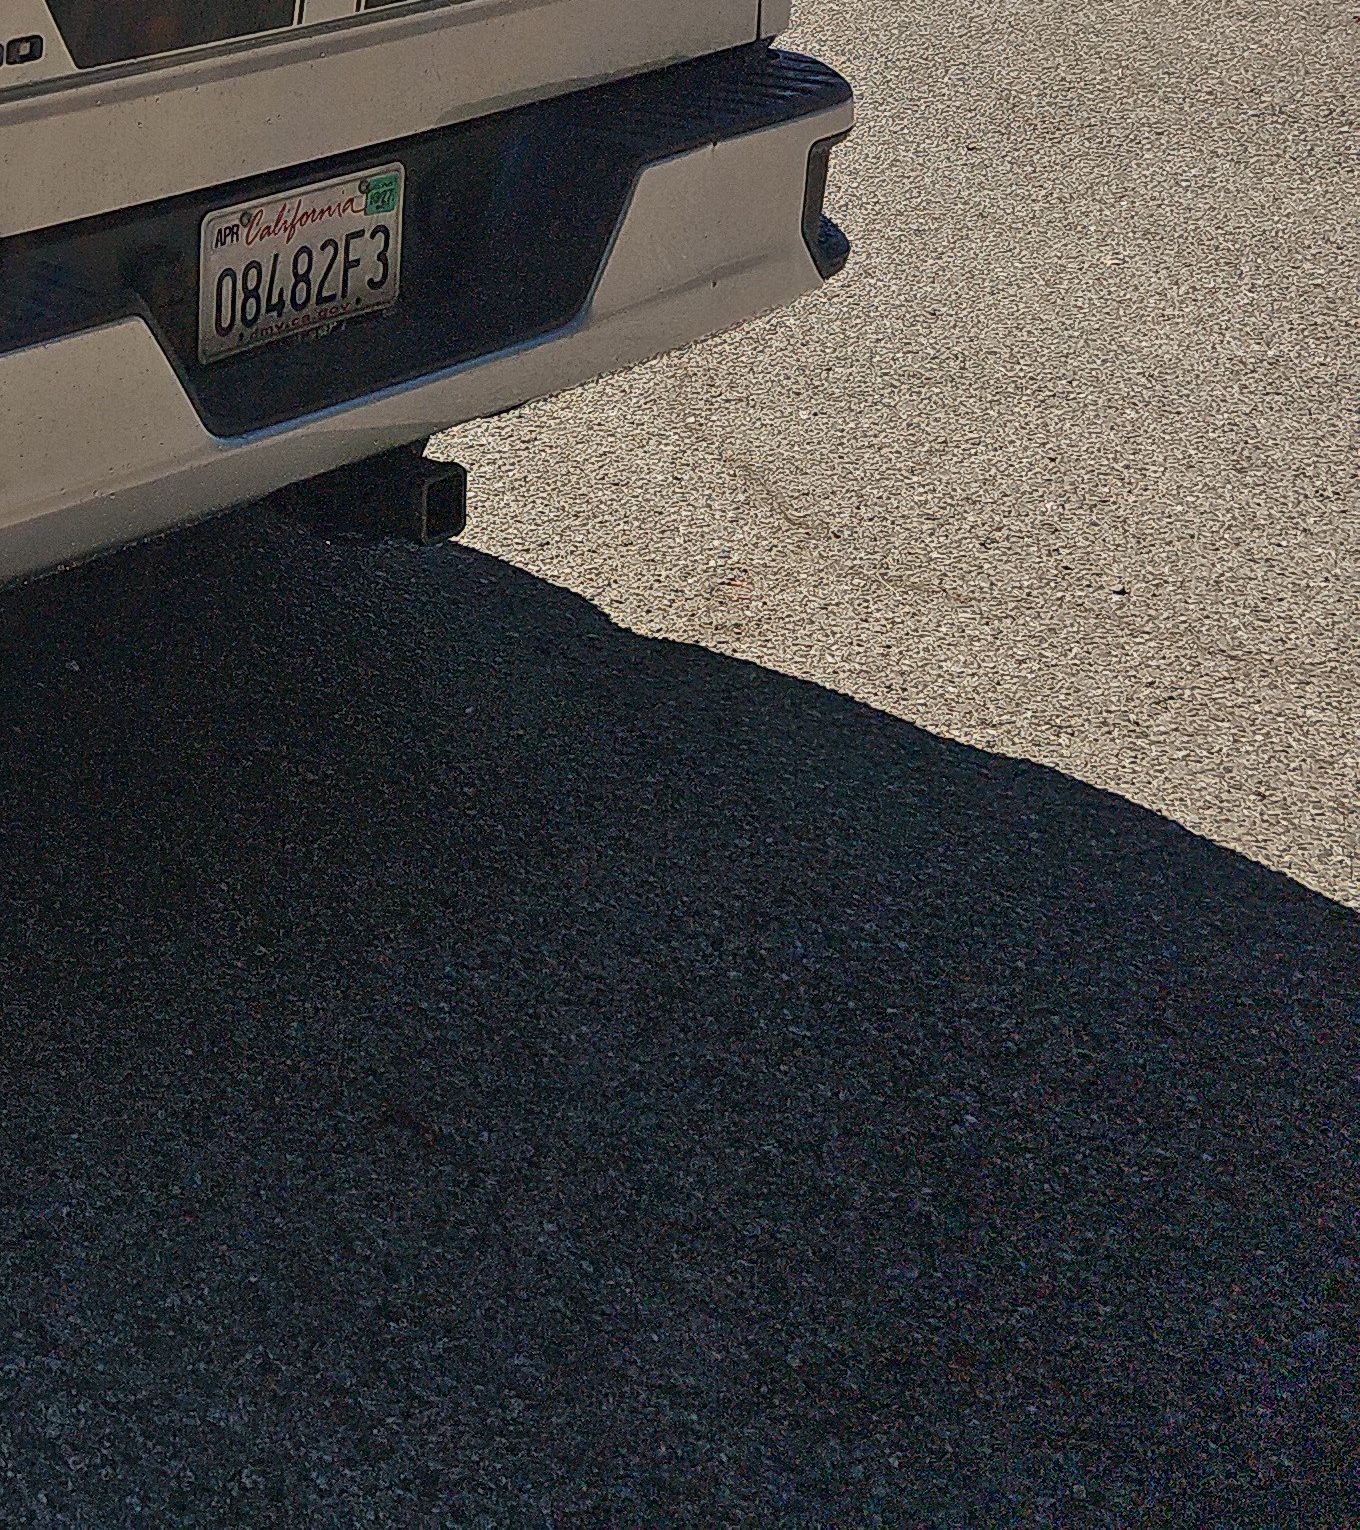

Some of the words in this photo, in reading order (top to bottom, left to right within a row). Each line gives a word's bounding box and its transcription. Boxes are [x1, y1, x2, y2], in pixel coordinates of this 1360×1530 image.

[214, 223, 240, 249] APR
[244, 190, 366, 246] California
[213, 223, 392, 338] 08482F3
